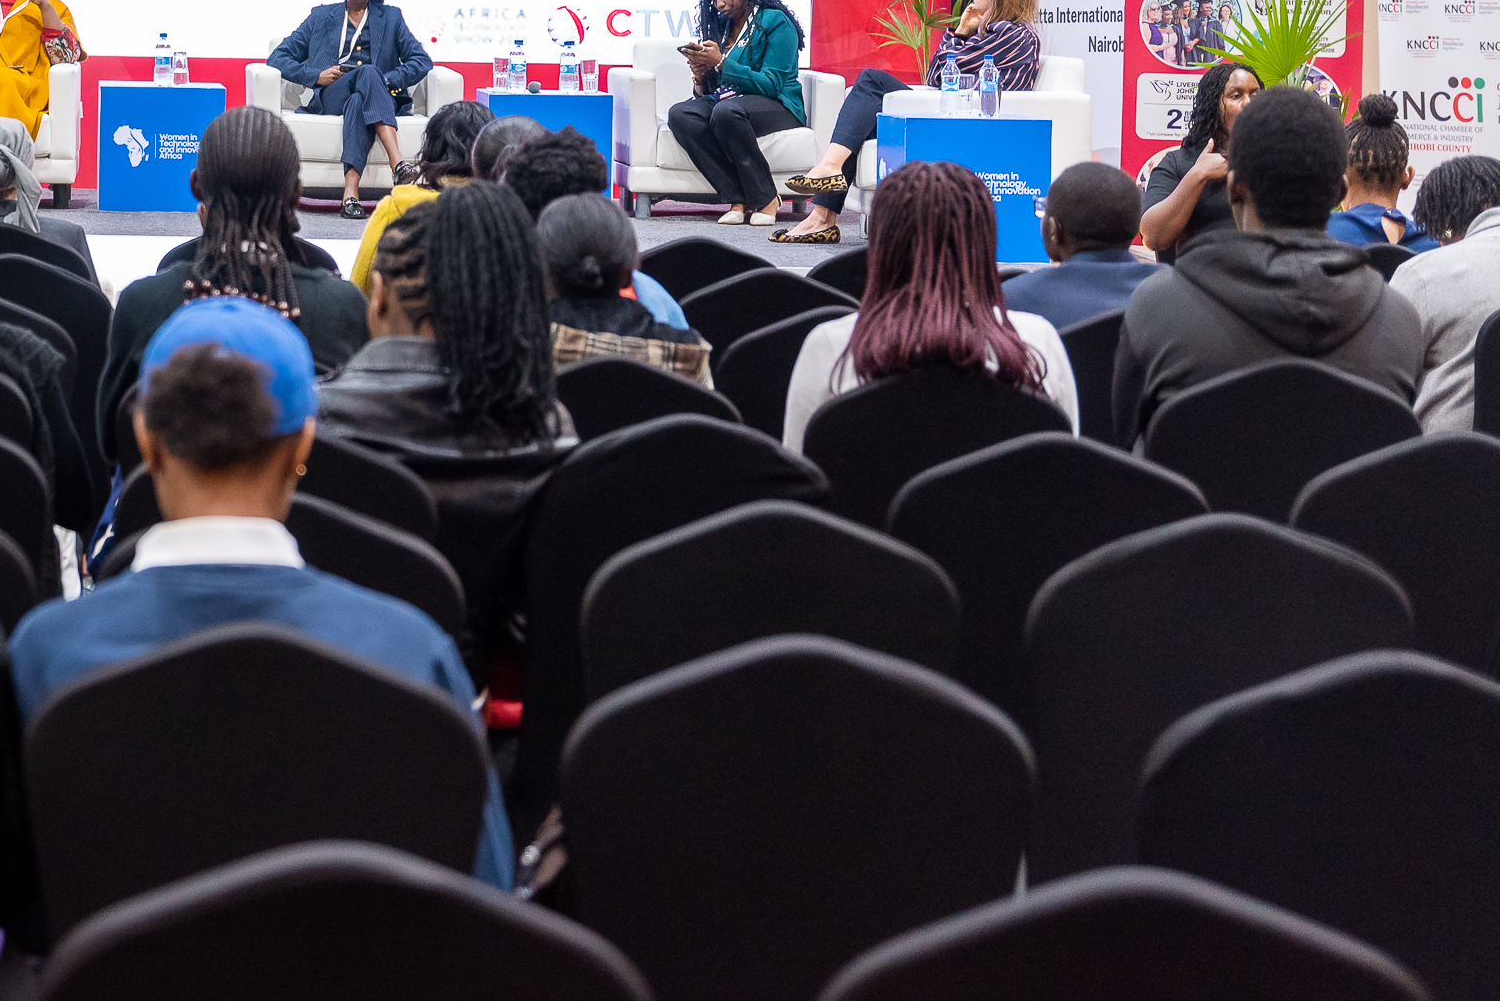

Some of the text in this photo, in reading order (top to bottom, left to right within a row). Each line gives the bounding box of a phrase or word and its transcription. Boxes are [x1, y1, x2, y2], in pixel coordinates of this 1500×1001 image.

[454, 8, 527, 19] AFRICA
[1404, 123, 1438, 132] NATIONAL
[1440, 125, 1473, 133] CHAMBER
[159, 133, 189, 141] Women
[1440, 135, 1474, 143] INDUSTRY
[1437, 144, 1472, 153] COUNTY
[975, 172, 1009, 180] Women
